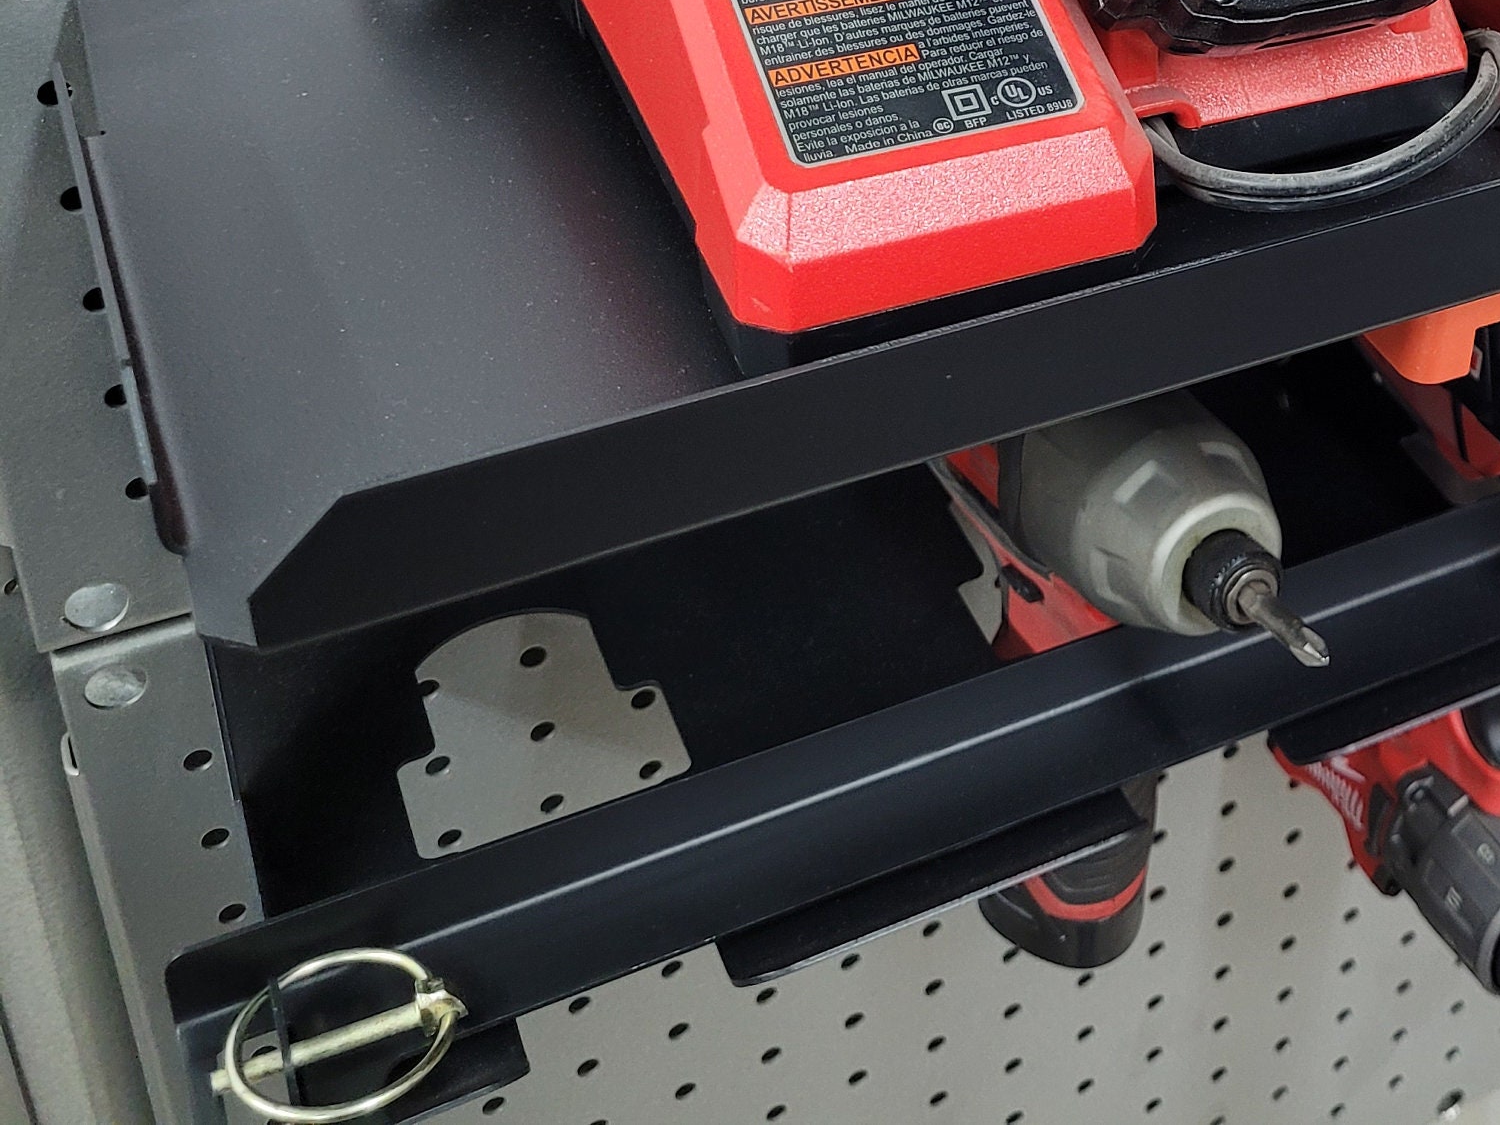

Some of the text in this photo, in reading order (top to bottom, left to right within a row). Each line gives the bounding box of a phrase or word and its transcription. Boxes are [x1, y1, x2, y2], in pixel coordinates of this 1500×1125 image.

[771, 46, 919, 85] ADVERTENCIA
[787, 103, 884, 131] provocar lesiones
[963, 116, 989, 129] BFP
[1005, 104, 1046, 120] LISTED
[790, 120, 854, 143] personales
[854, 120, 863, 128] o
[795, 118, 920, 151] Evite la exposicion a la
[843, 138, 881, 154] Made
[881, 135, 895, 146] in
[895, 127, 933, 143] China
